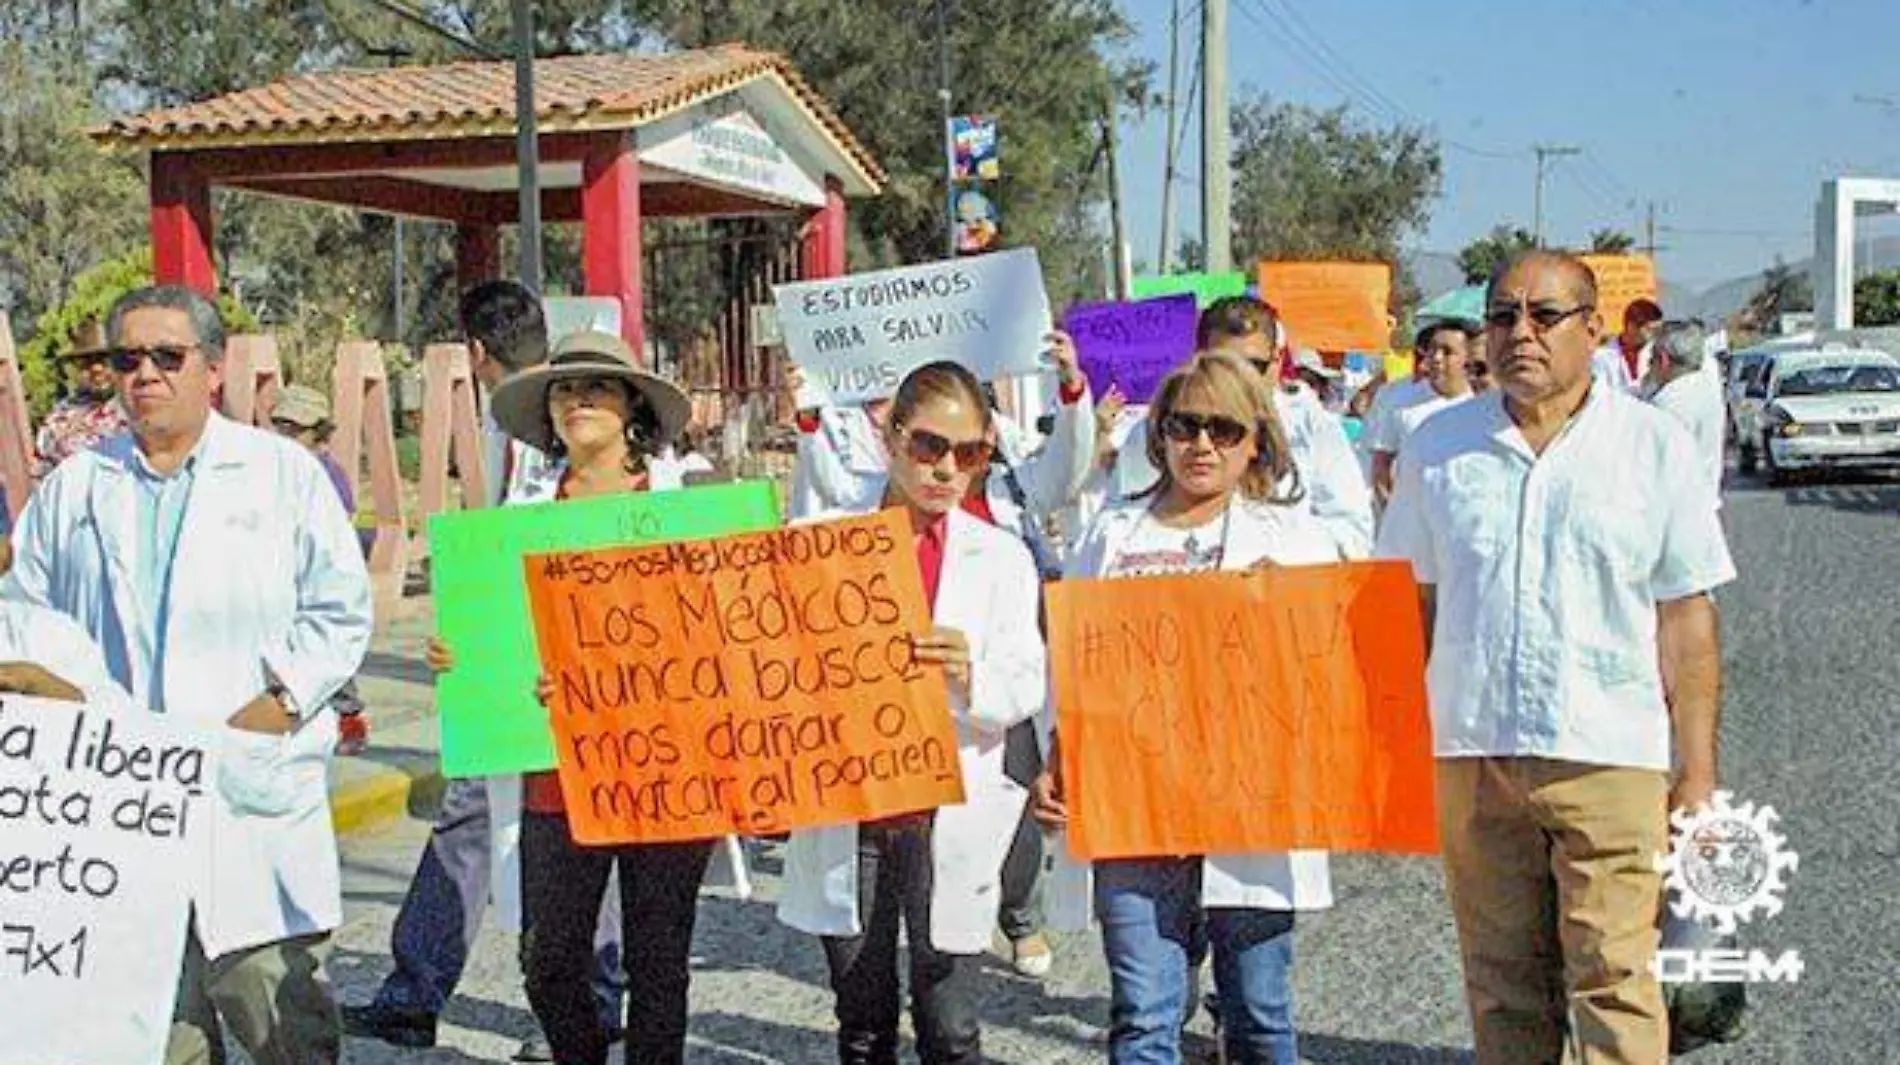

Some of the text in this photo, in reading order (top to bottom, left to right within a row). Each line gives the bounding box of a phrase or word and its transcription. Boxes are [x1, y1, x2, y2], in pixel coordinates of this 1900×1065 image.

[813, 325, 866, 353] PARA
[569, 593, 661, 649] Los
[562, 654, 727, 715] Nunca
[66, 710, 204, 786] libera
[572, 723, 680, 772] mos
[704, 711, 844, 761] dañar
[750, 763, 797, 807] al
[112, 790, 190, 838] del
